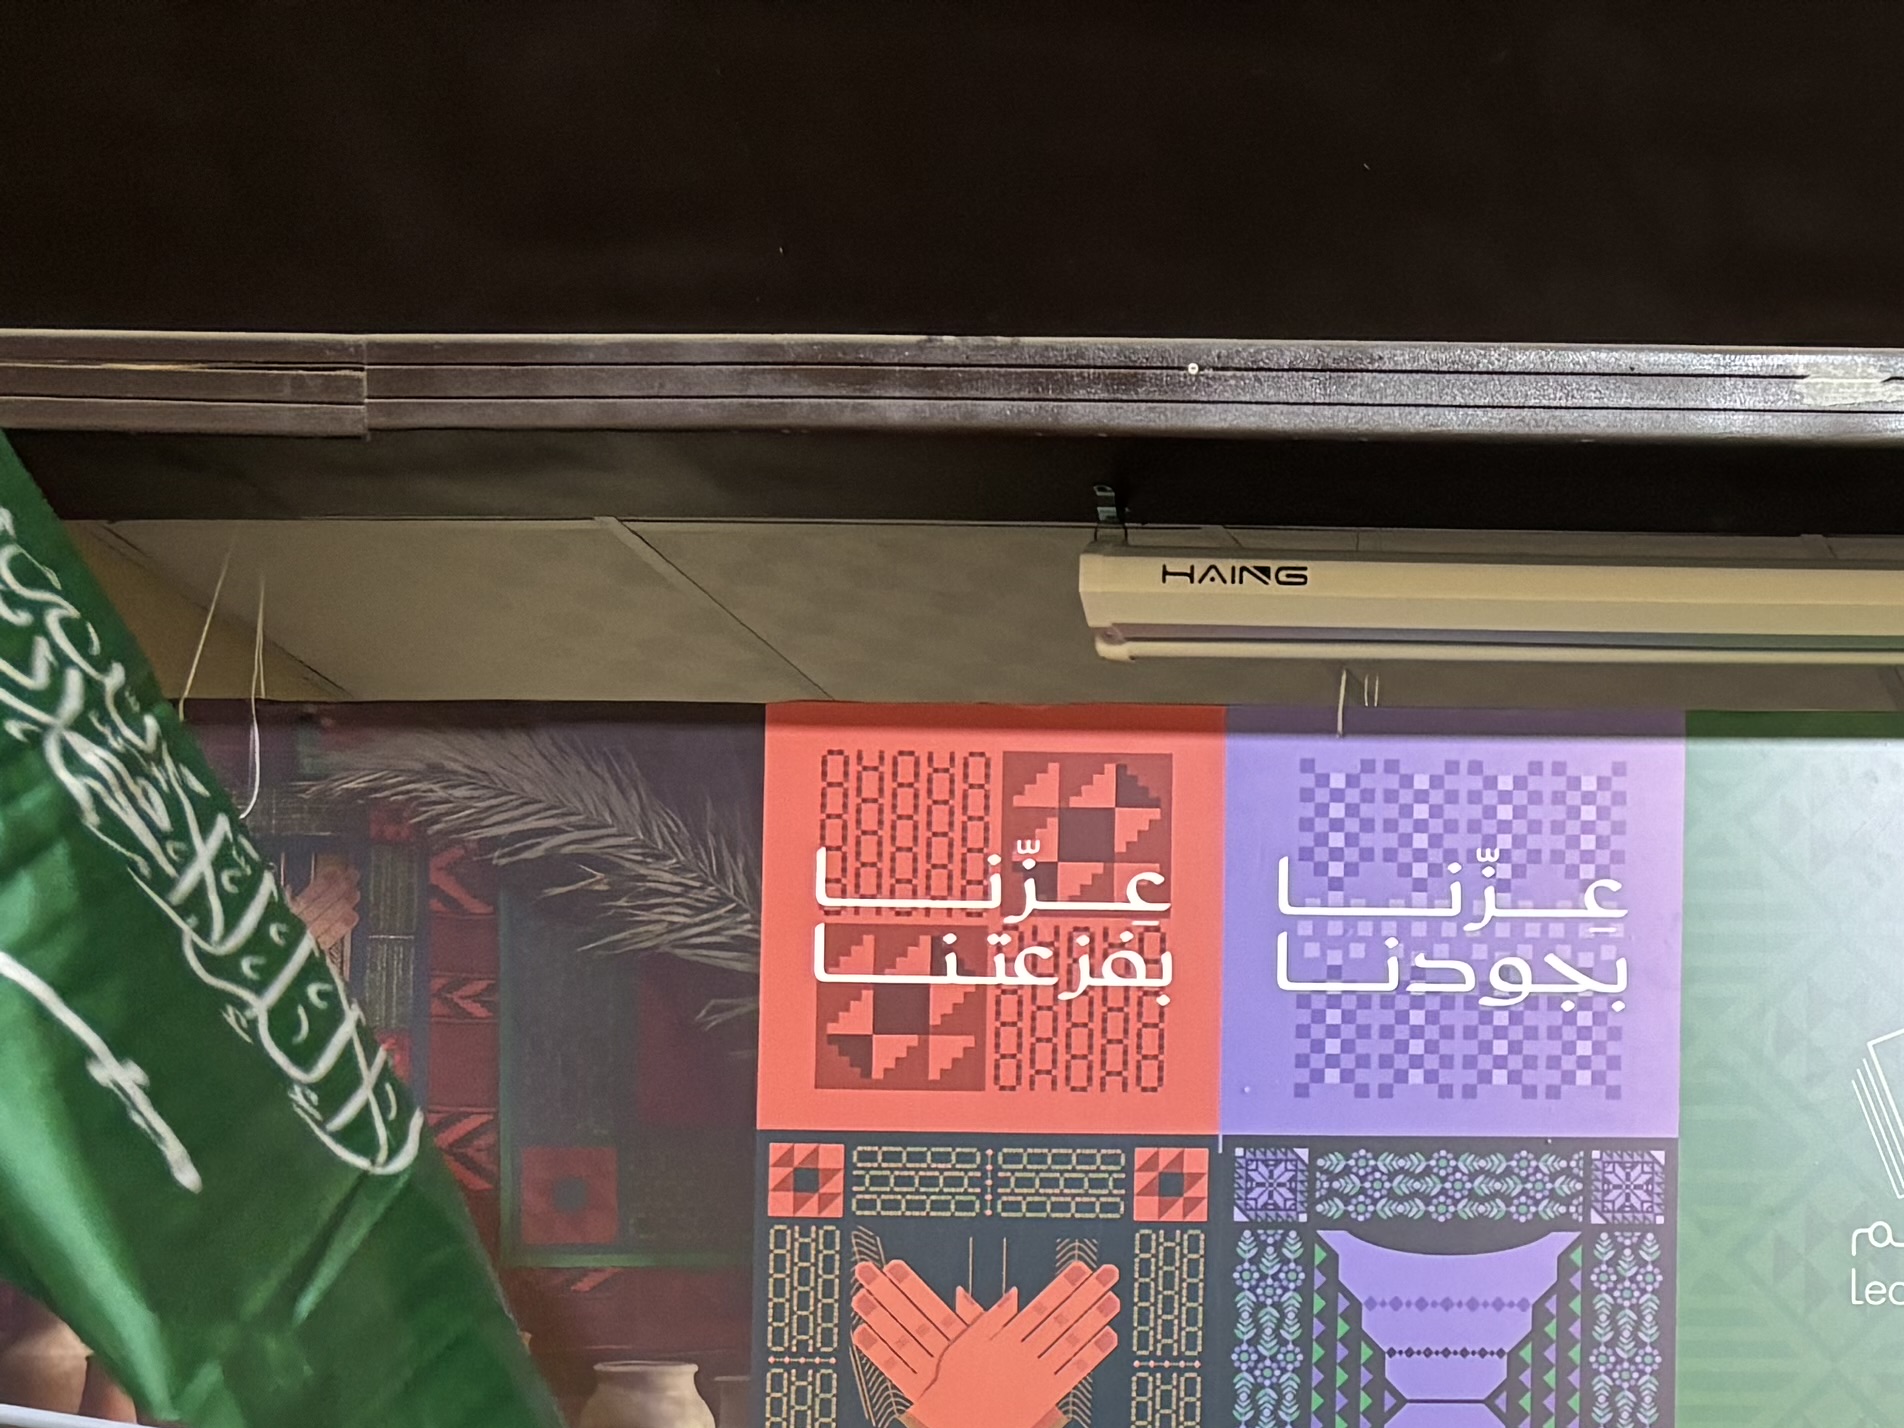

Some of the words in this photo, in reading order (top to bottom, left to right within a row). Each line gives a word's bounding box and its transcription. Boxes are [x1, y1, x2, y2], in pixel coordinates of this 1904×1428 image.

[1161, 564, 1308, 586] HAING
[811, 921, 1176, 1007] بفزعتنا
[1274, 929, 1629, 1013] بجودنا
